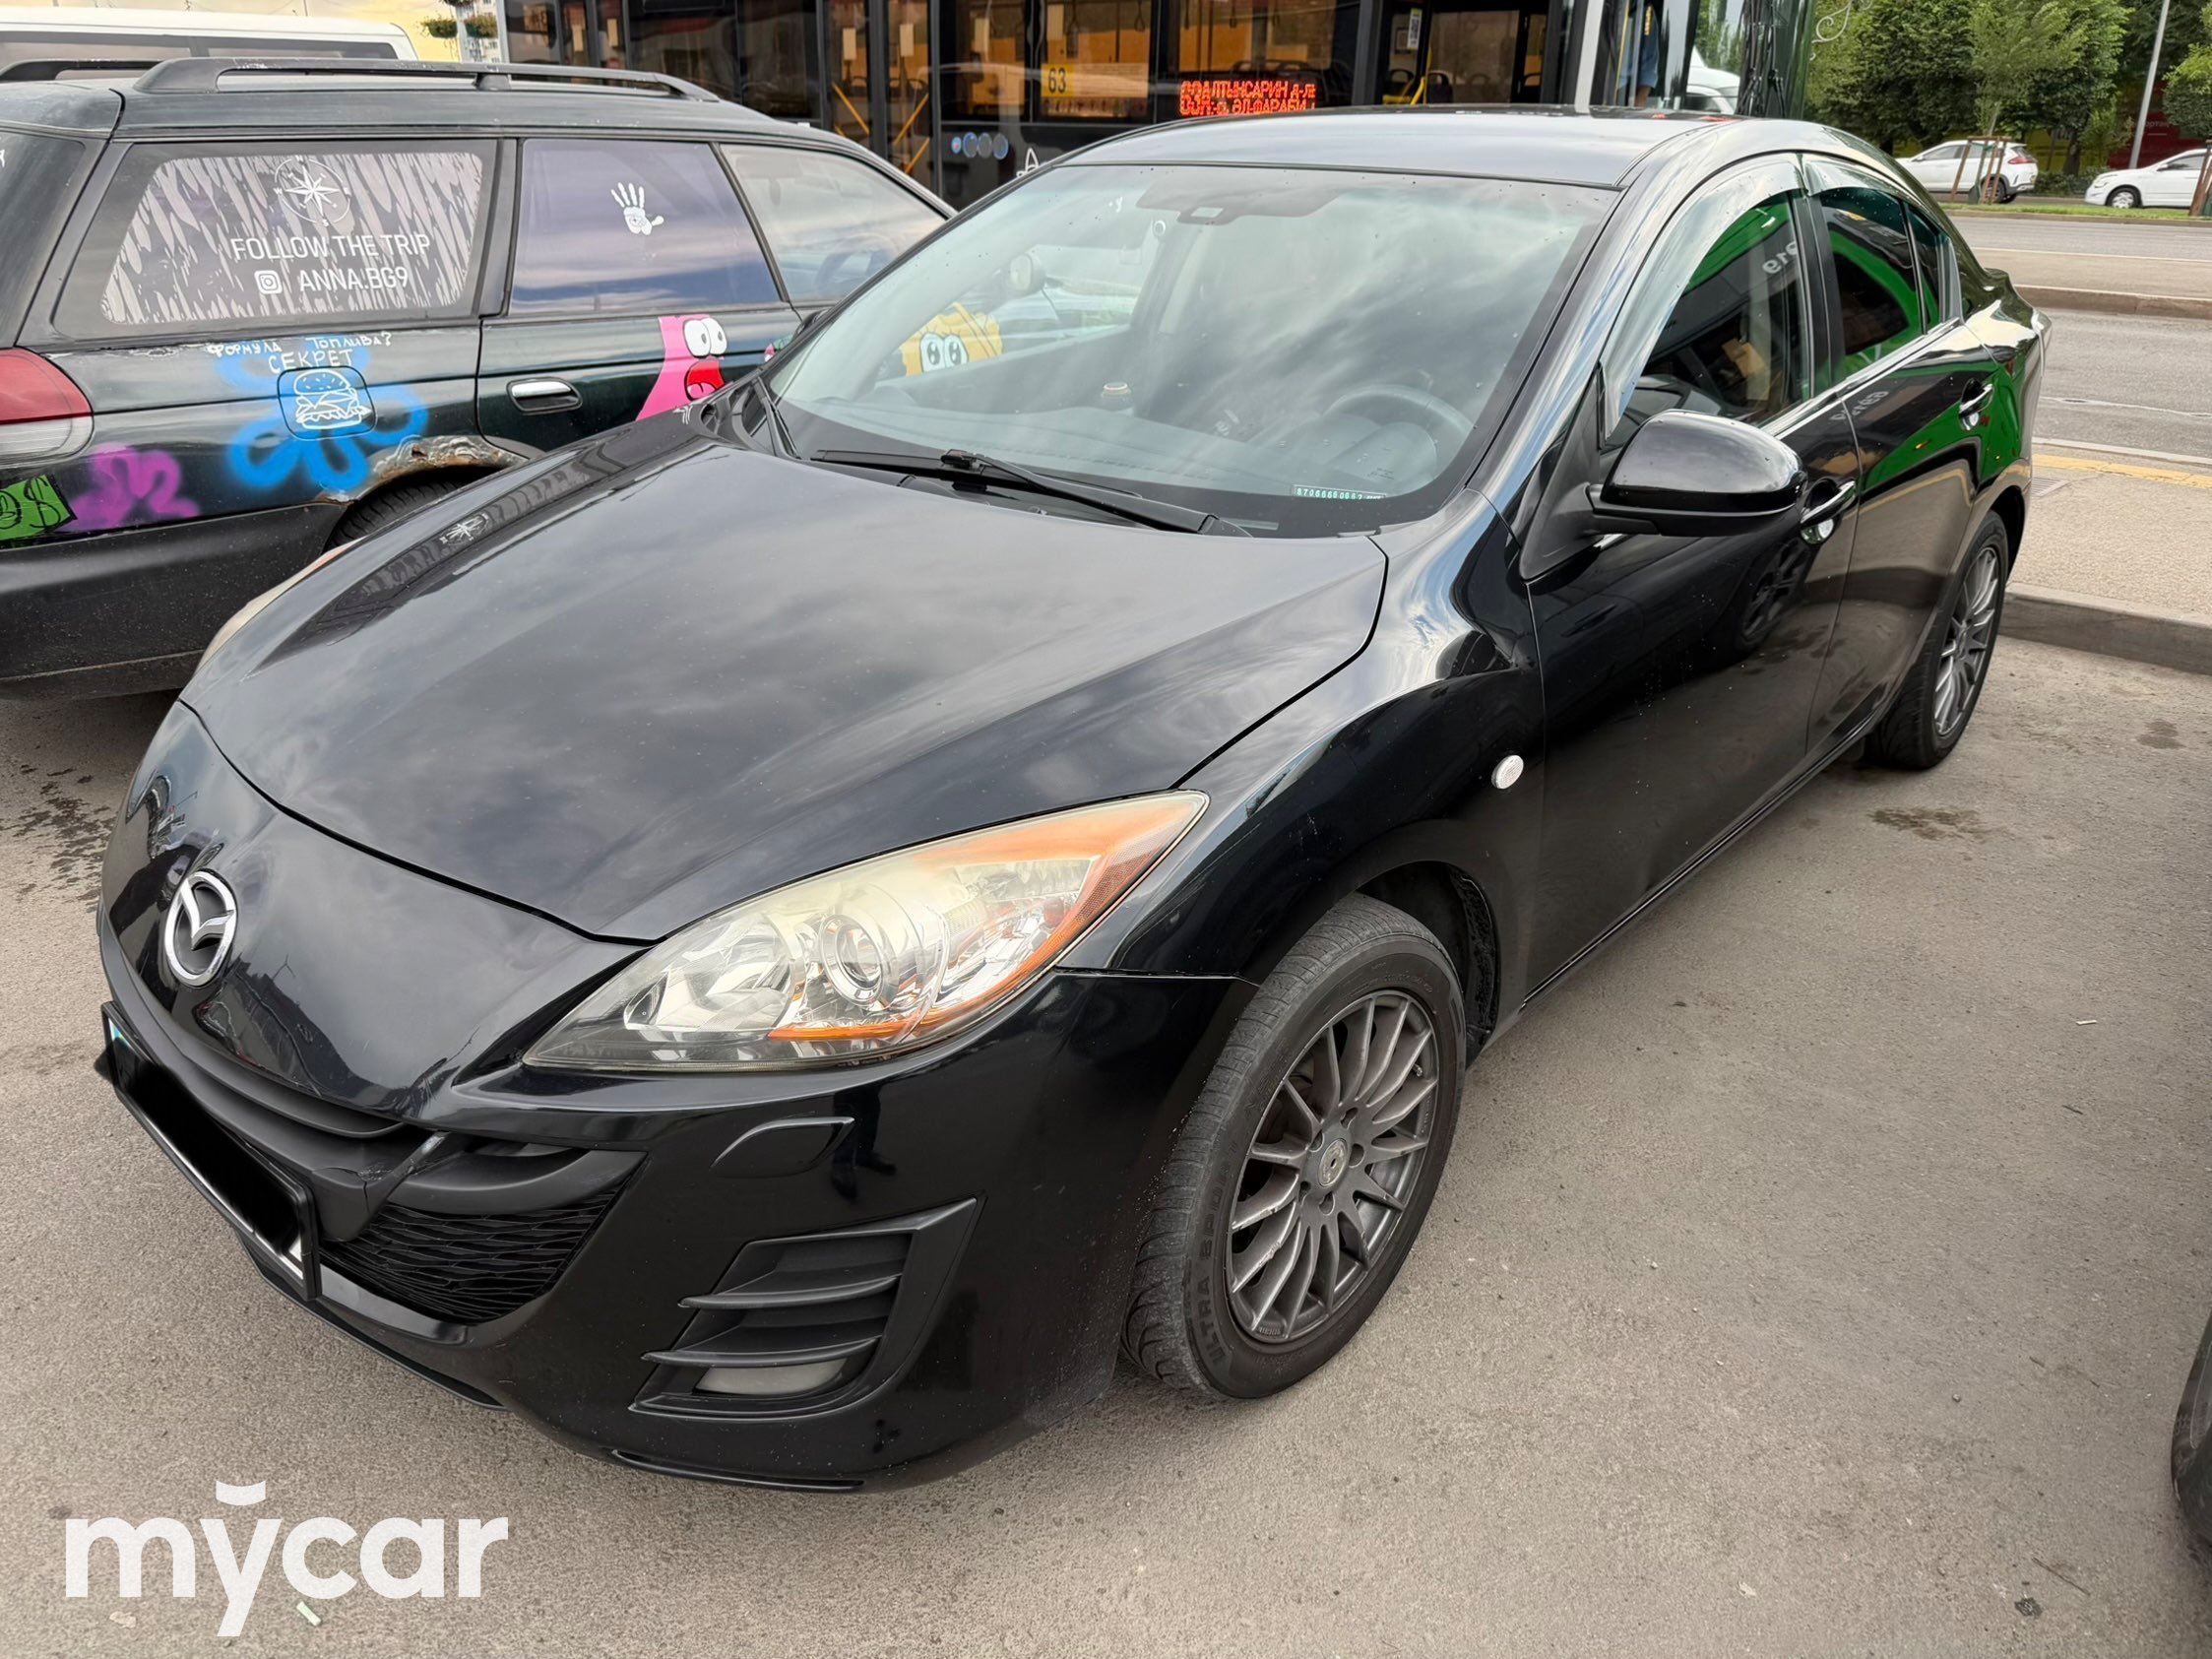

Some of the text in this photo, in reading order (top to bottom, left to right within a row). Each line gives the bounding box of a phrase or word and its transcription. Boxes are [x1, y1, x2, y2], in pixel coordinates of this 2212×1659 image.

[1047, 67, 1067, 95] 63
[230, 233, 431, 261] FOLLOW THE TRIP
[298, 266, 409, 293] ANNA.BG9
[268, 349, 353, 374] СЕКРЕТ
